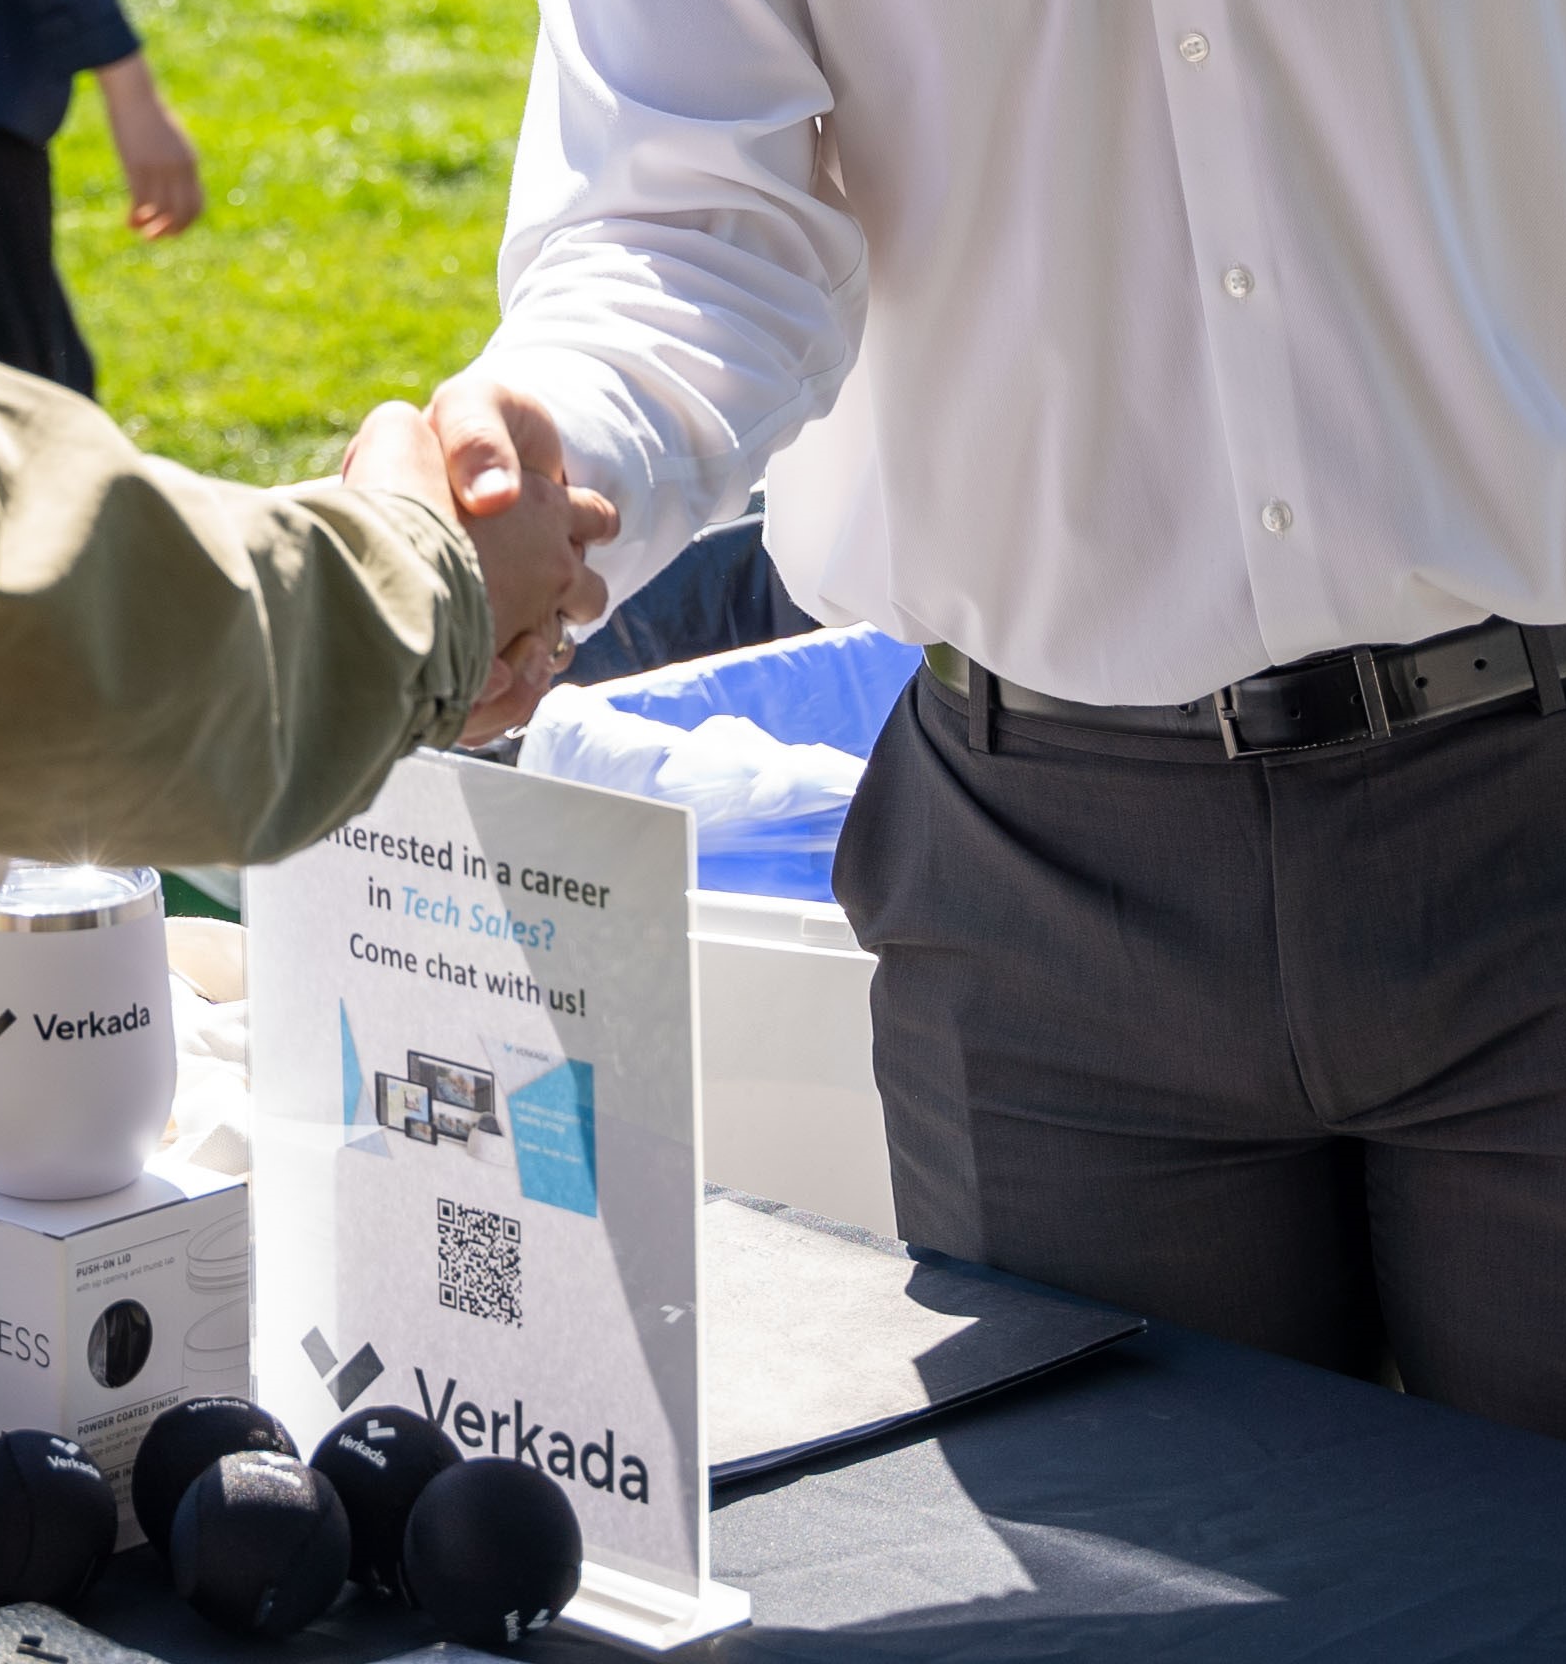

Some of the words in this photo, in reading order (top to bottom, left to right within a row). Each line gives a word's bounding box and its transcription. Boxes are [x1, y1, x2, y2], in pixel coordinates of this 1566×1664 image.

[462, 846, 486, 881] in
[496, 861, 512, 887] a
[520, 866, 611, 910] career
[367, 876, 392, 911] in
[401, 885, 461, 929] Tech
[468, 903, 556, 951] Sales?
[349, 932, 418, 974] Come
[425, 952, 478, 989] chat
[485, 971, 541, 1005] with
[548, 988, 587, 1018] us!
[32, 1001, 151, 1041] Verkada
[76, 1259, 116, 1279] PUSH-ON
[117, 1252, 132, 1267] LID
[77, 1415, 115, 1437] POWDER
[116, 1404, 149, 1424] COATED
[151, 1394, 179, 1412] FINISH
[413, 1366, 649, 1505] Verkada
[338, 1433, 387, 1469] Verkada
